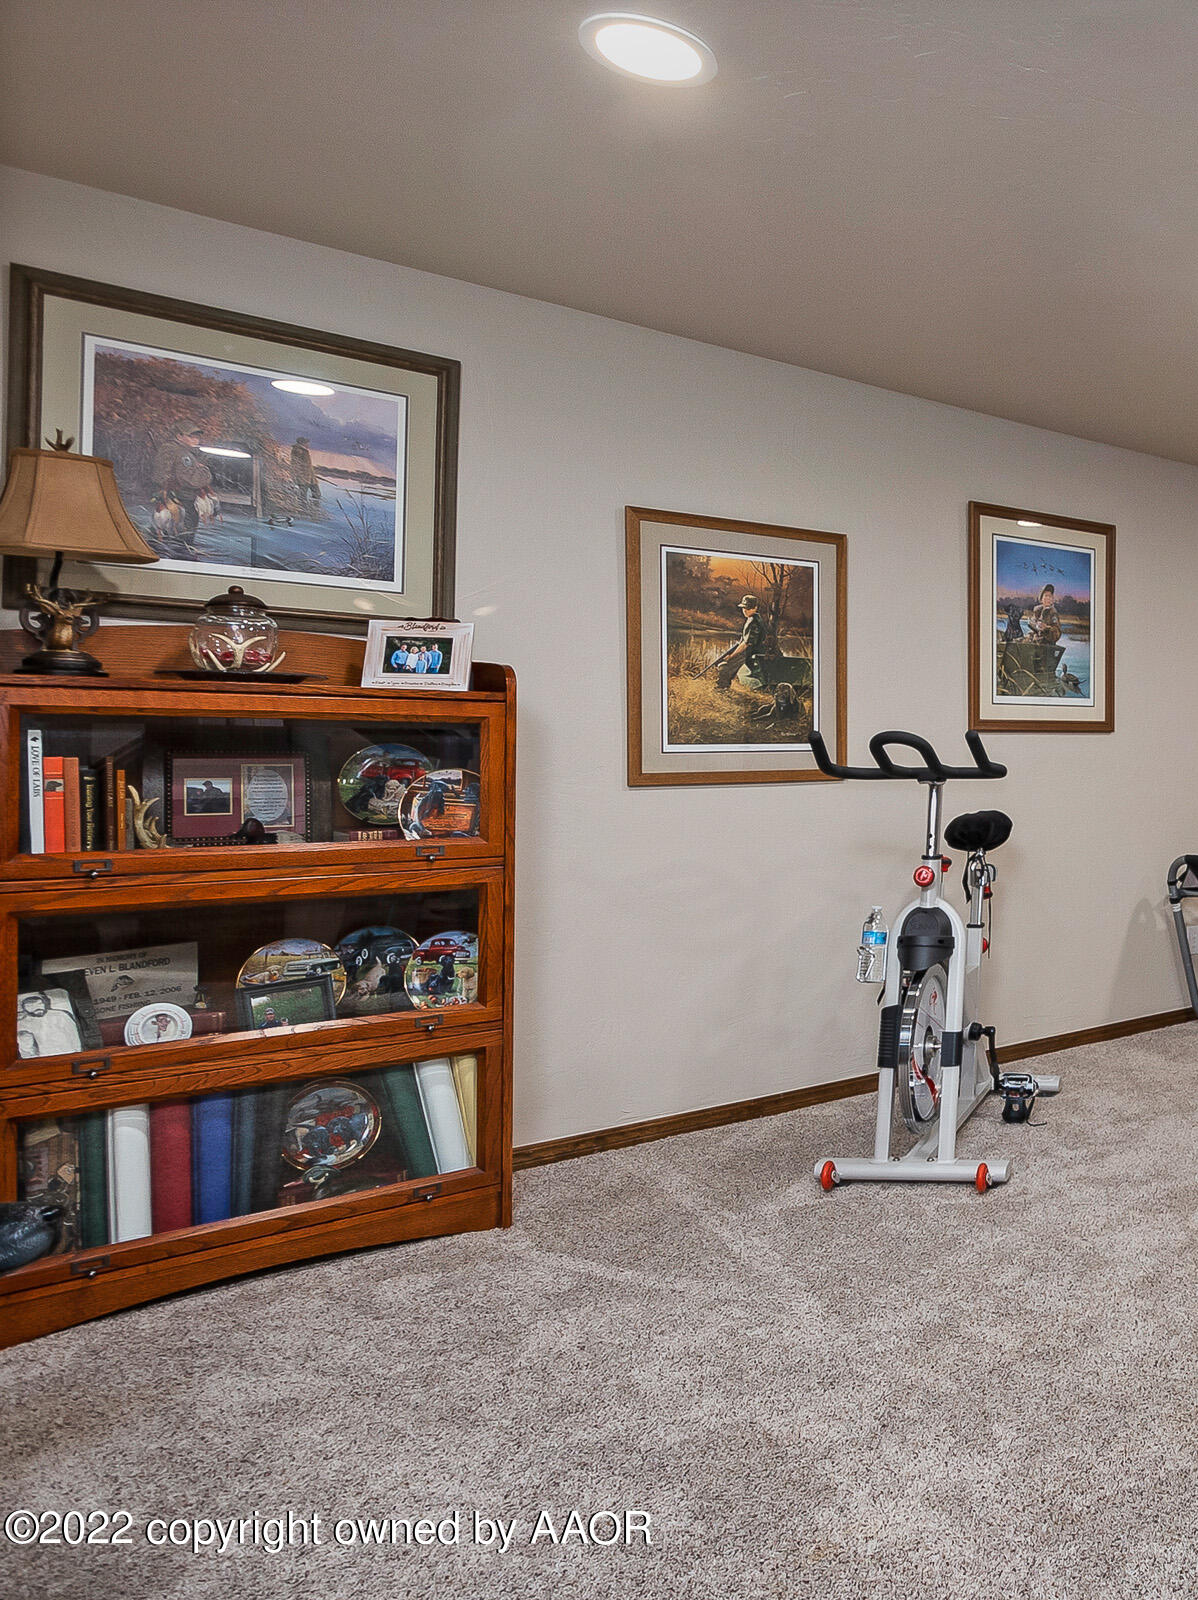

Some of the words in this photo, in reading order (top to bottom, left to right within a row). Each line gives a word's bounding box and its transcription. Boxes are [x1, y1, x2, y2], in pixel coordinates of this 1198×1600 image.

[31, 745, 40, 766] LOVE
[32, 767, 40, 777] OF
[33, 779, 41, 798] LABS
[118, 957, 171, 972] BLANDFORD
